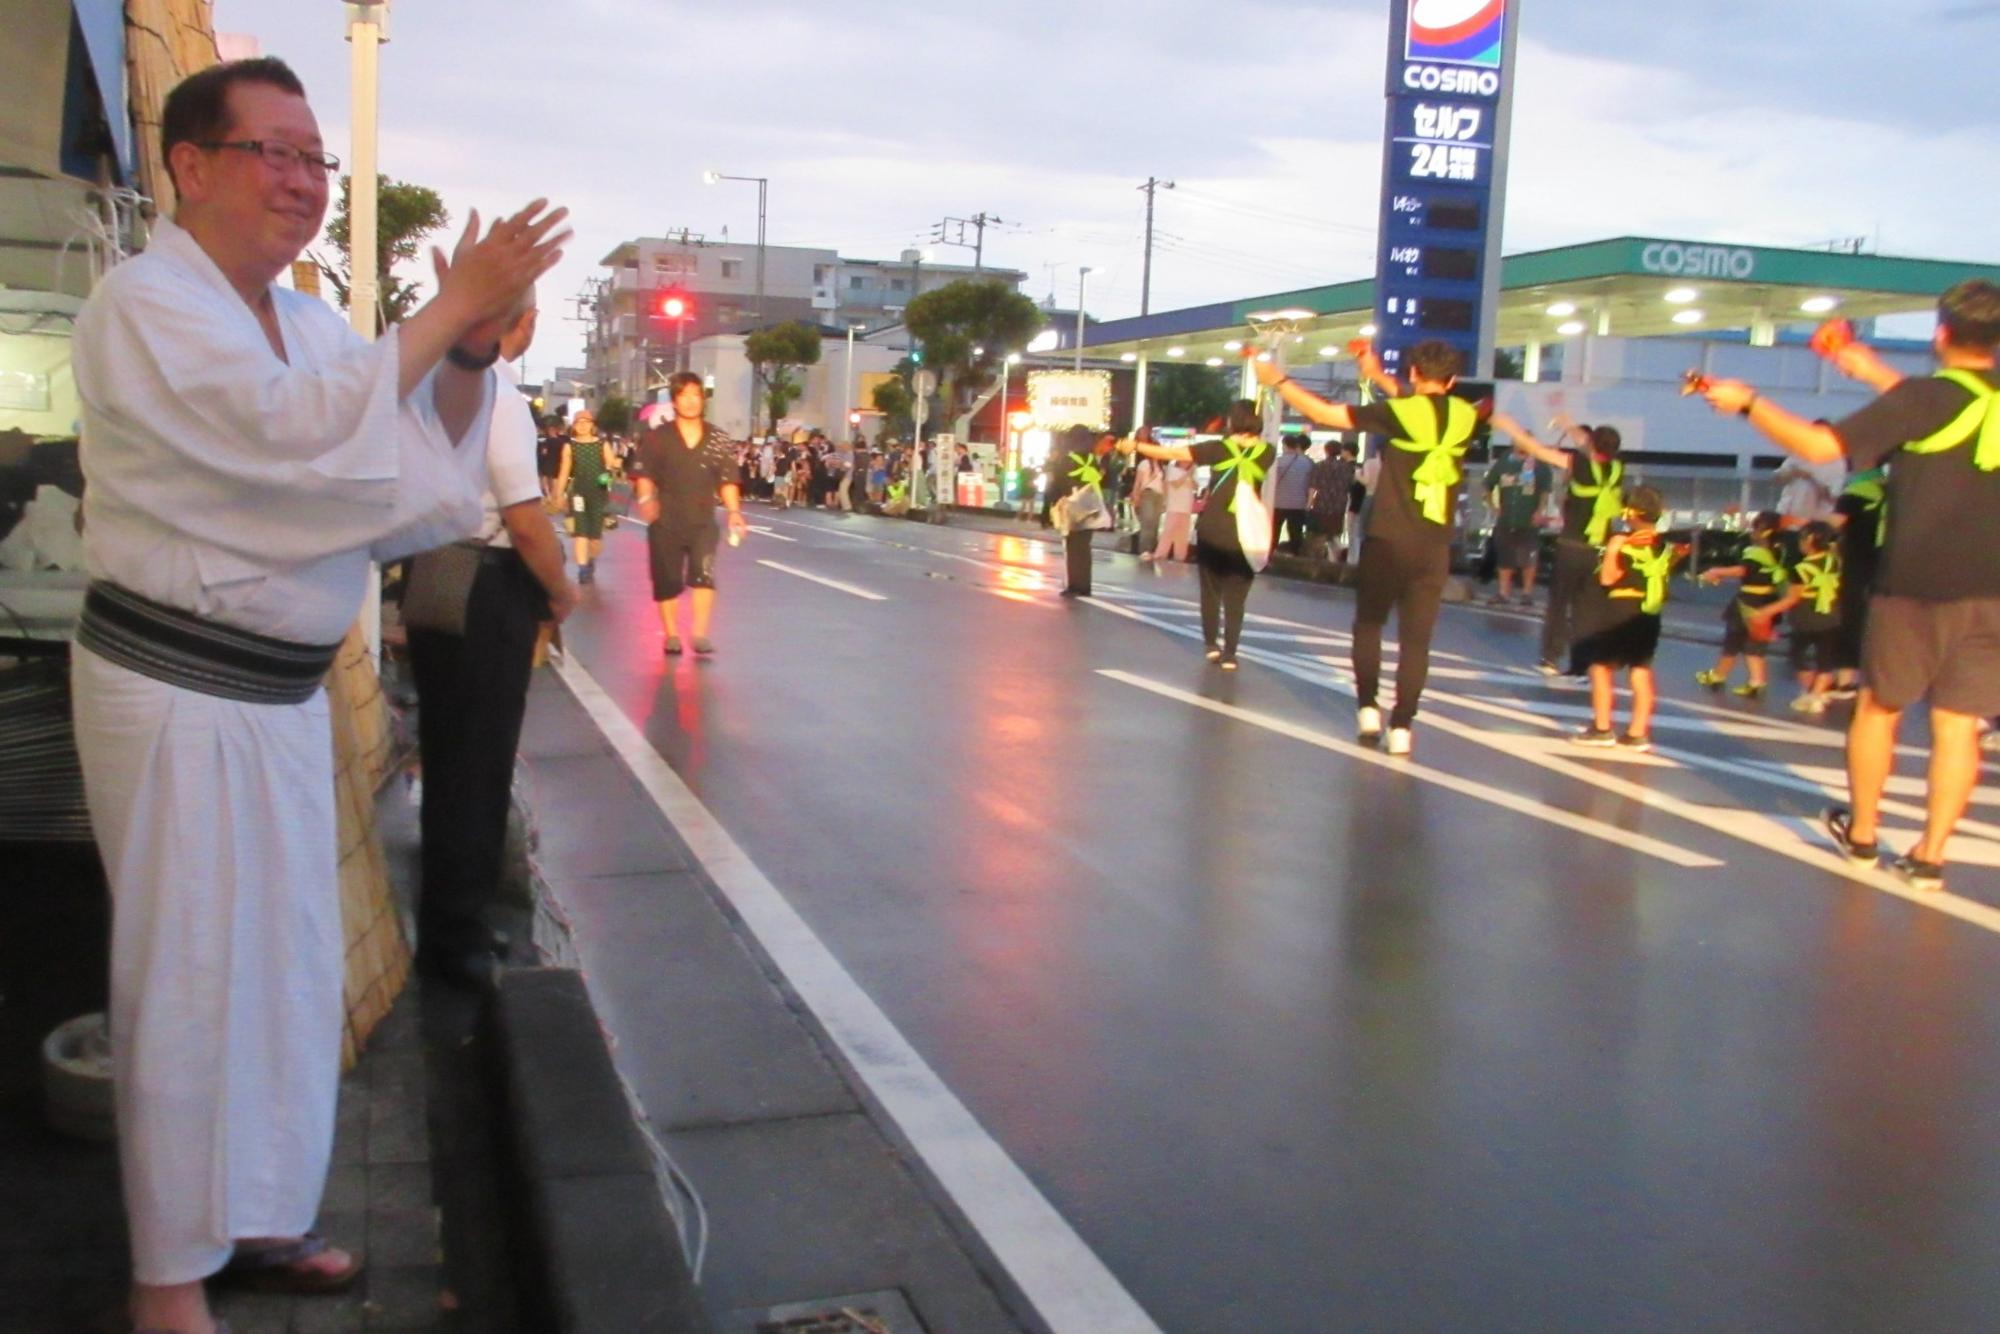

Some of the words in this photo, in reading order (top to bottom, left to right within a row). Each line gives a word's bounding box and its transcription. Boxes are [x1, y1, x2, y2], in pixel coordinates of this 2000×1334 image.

[1403, 65, 1499, 97] COSMO
[1413, 103, 1481, 141] セルフ
[1641, 242, 1755, 279] COSMO
